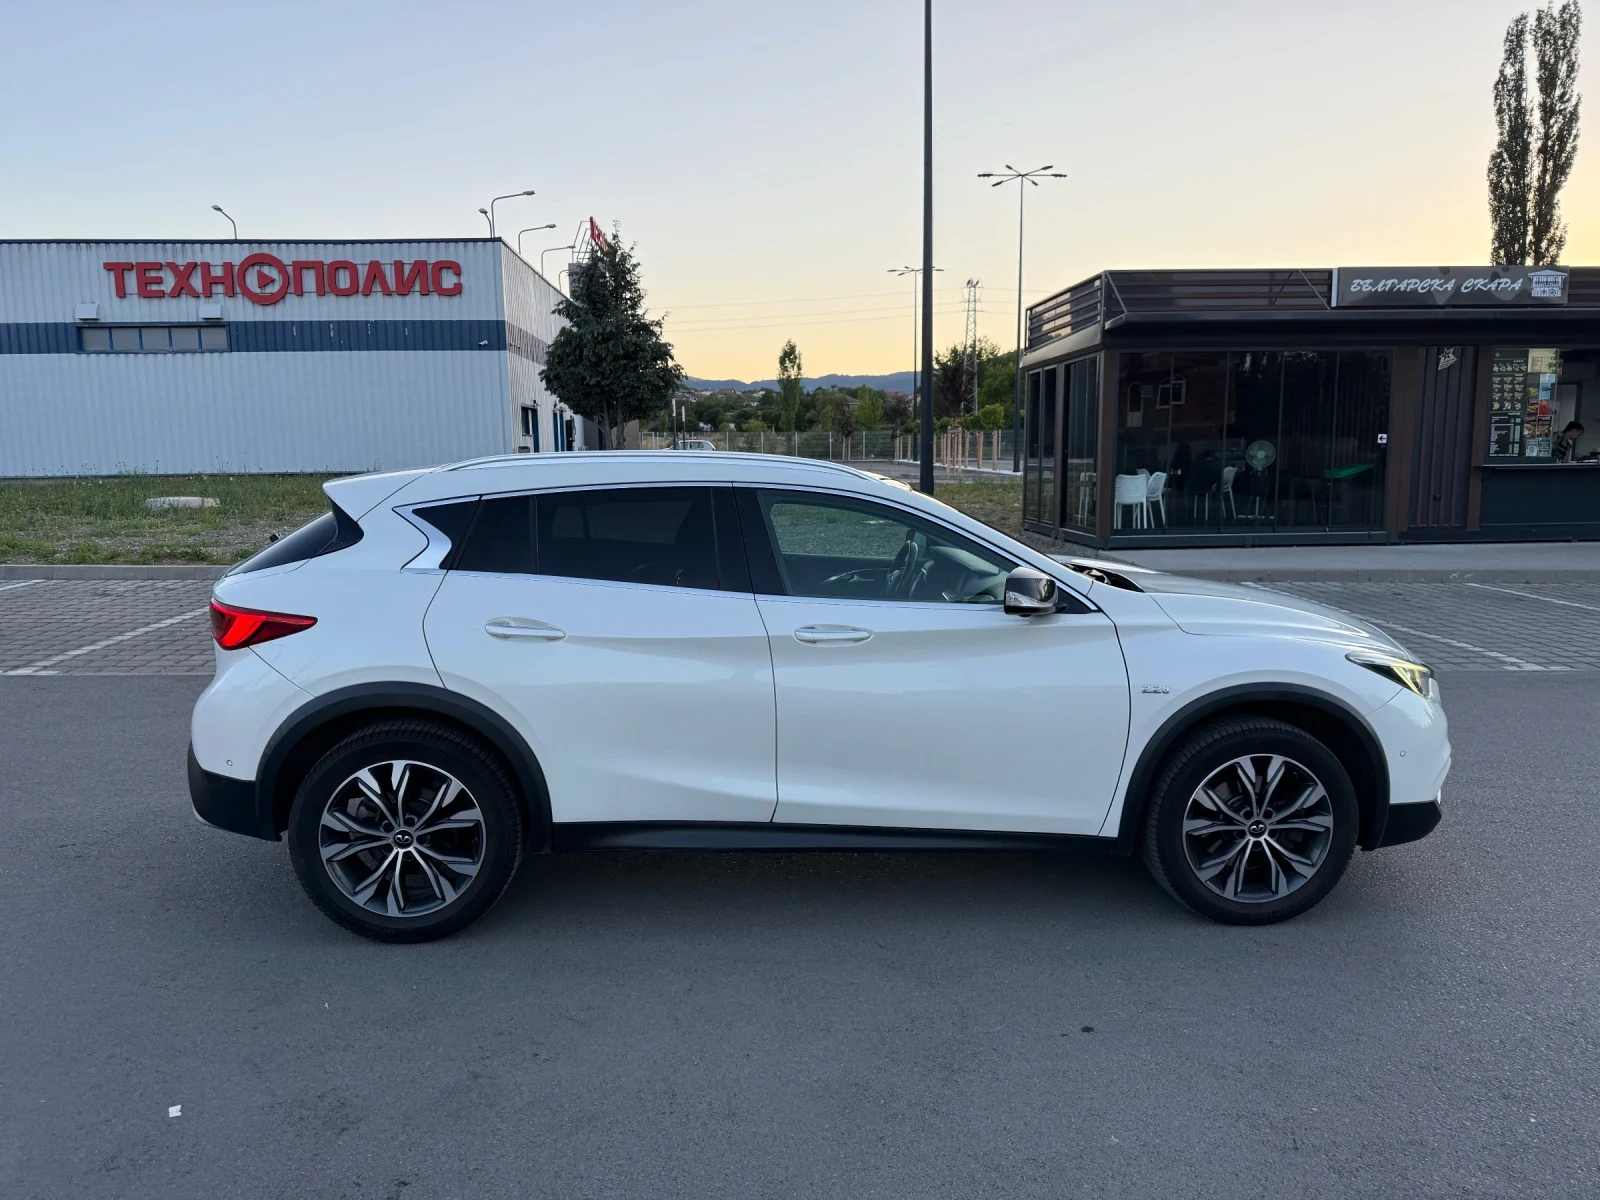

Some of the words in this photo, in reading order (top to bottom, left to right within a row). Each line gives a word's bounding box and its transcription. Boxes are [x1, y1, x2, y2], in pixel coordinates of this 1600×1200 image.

[103, 252, 463, 306] ТЕХНОПОЛИС
[1350, 278, 1456, 293] БЪЛГАРСКА
[1460, 277, 1523, 293] СКАРА
